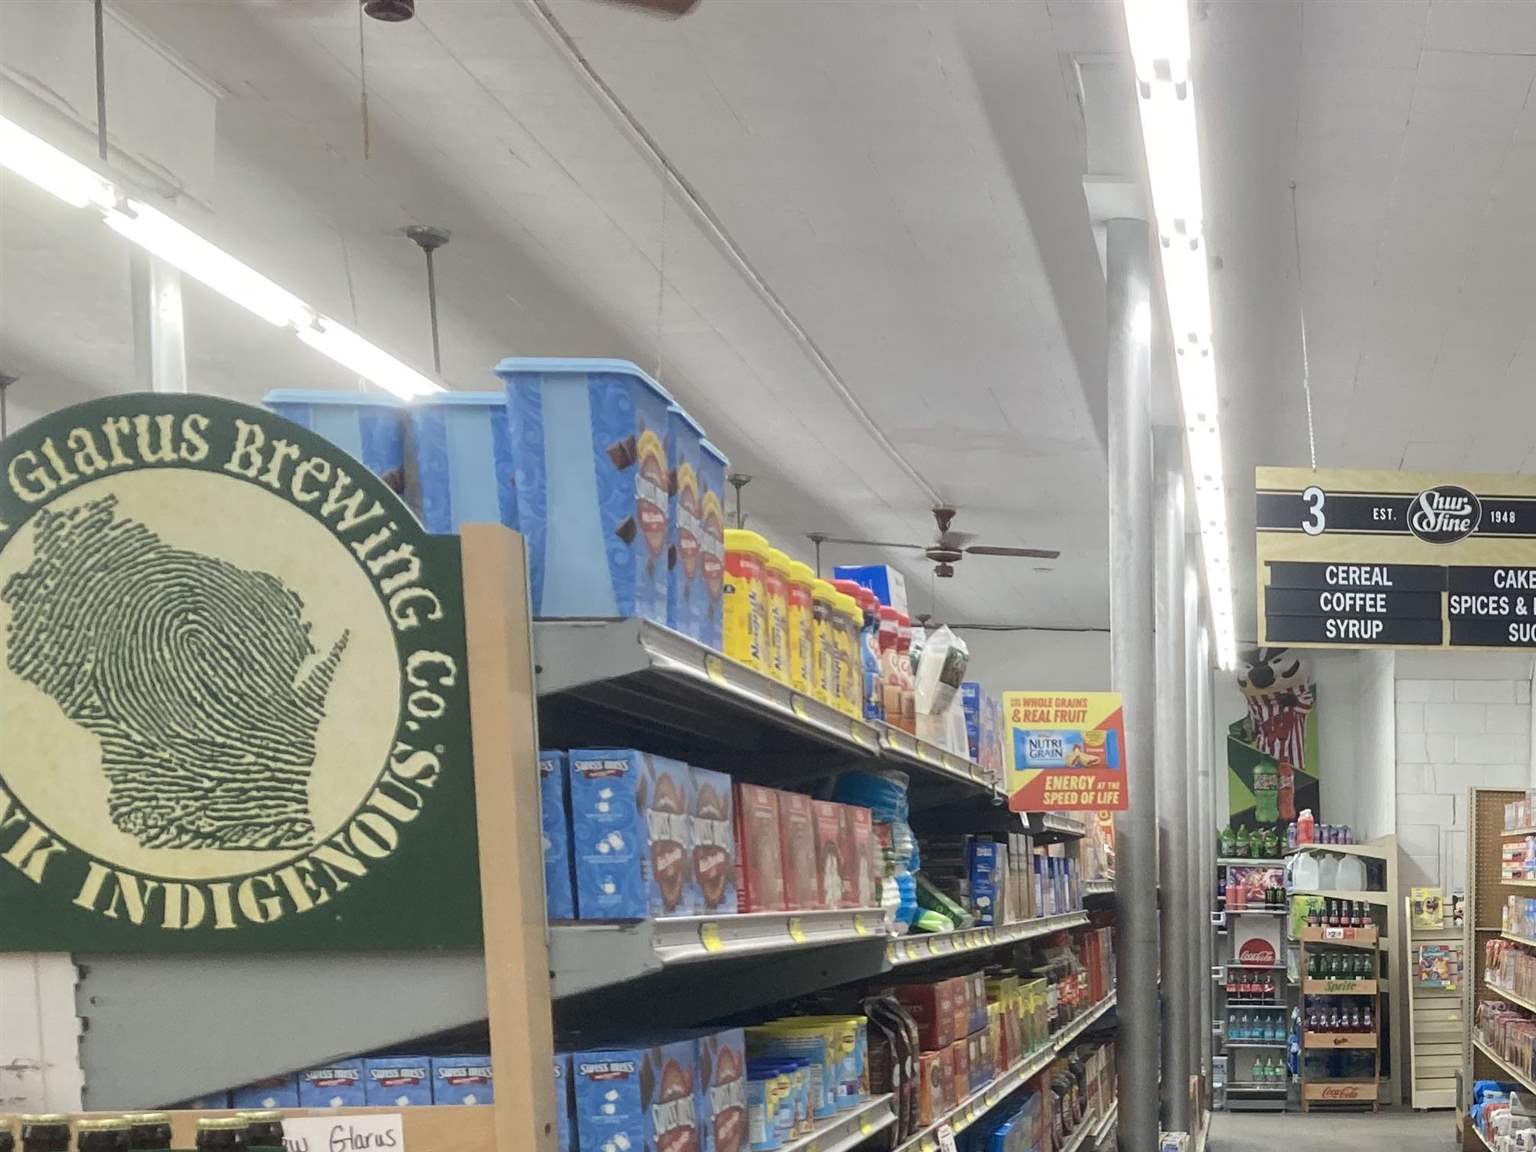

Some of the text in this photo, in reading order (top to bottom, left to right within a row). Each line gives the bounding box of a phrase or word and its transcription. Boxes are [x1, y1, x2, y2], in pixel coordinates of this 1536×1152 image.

[1302, 486, 1326, 535] 3
[1373, 507, 1516, 524] EST. 1948
[7, 412, 211, 503] Glarus
[405, 648, 458, 733] Co.
[1325, 565, 1393, 587] CEREAL
[1319, 592, 1387, 613] COFFEE
[1450, 596, 1508, 615] SPICES
[1515, 597, 1528, 616] &
[1325, 619, 1384, 639] SYRUP
[1023, 697, 1053, 708] WHOLE
[1055, 698, 1088, 708] GRAINS
[1012, 710, 1088, 723] & REAL FRUIT
[1029, 738, 1062, 749] NUTRI
[1029, 749, 1063, 759] GRAIN
[1045, 776, 1096, 790] ENERGY
[1043, 792, 1120, 805] SPEED OF LIFE
[72, 743, 441, 931] INDIGENOUS
